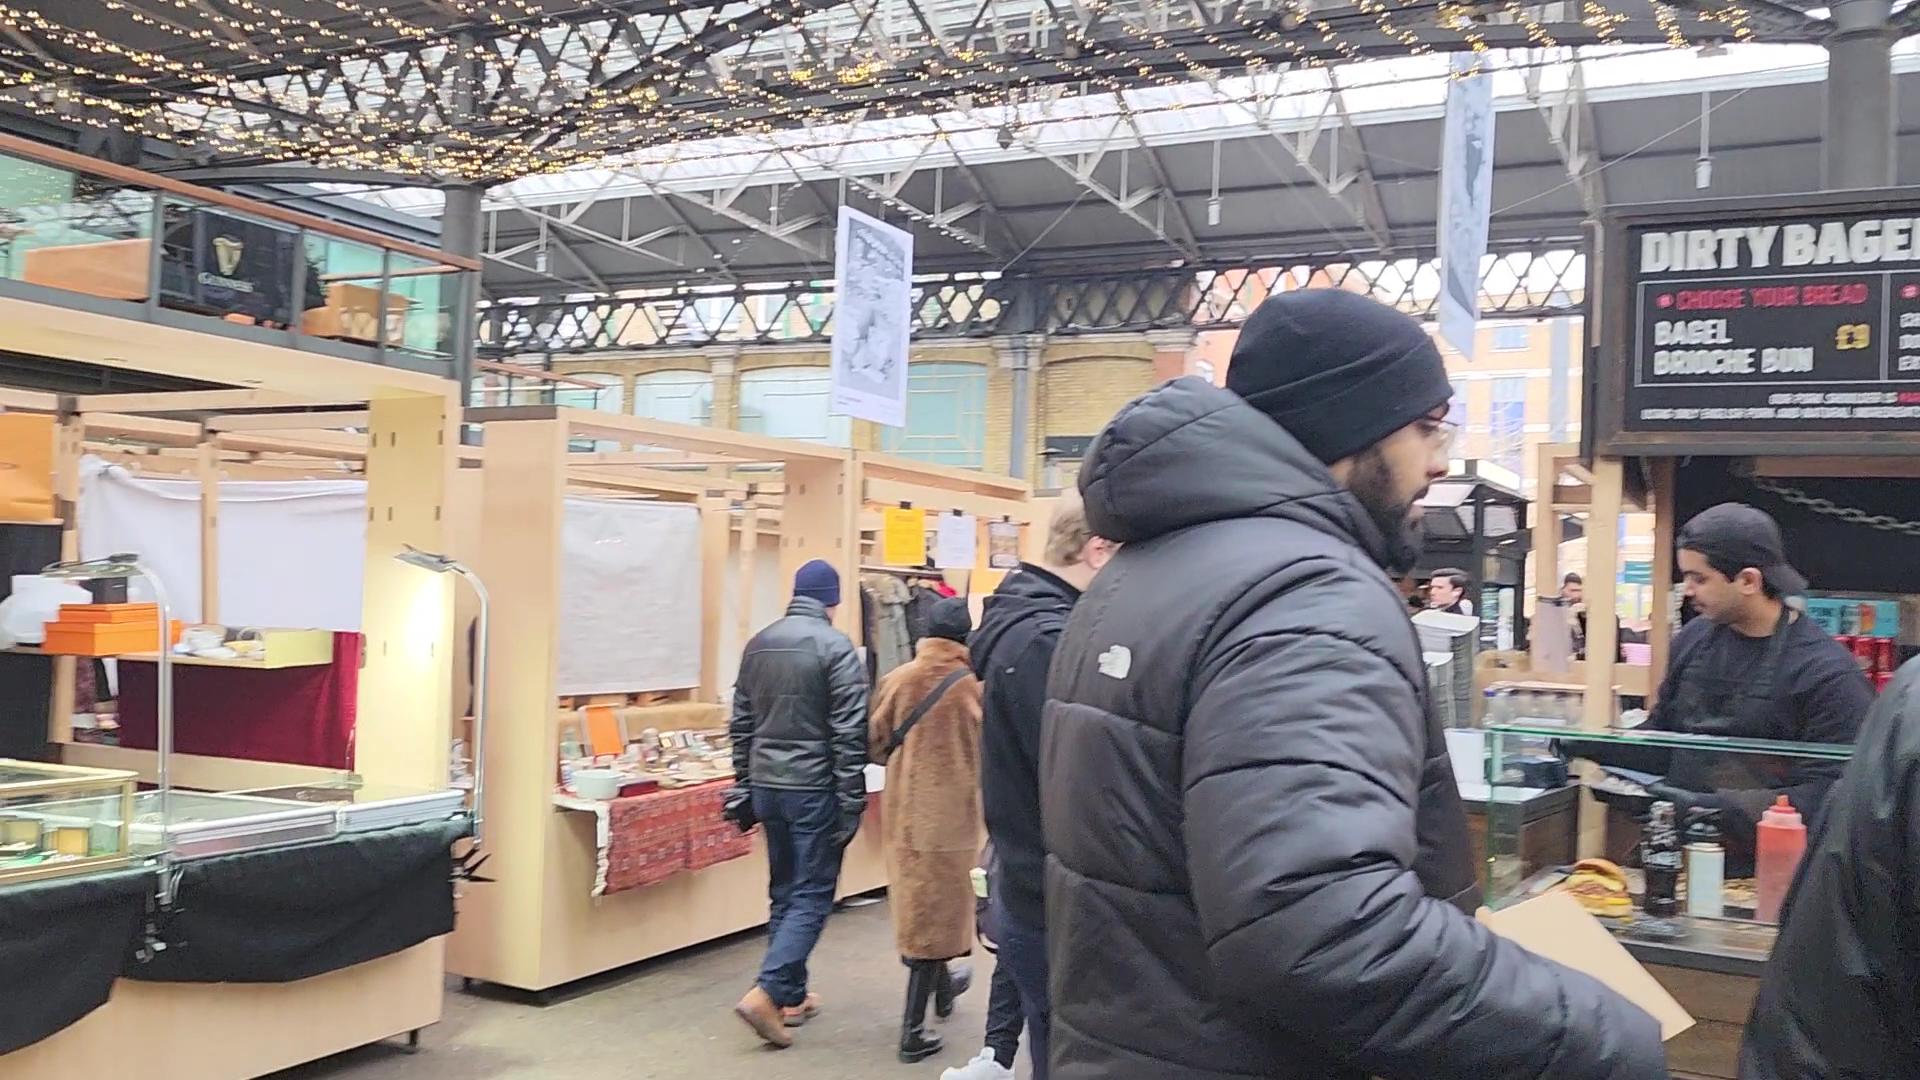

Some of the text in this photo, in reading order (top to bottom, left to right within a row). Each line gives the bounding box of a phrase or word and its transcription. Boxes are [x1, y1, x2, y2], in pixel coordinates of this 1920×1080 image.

[1640, 226, 1780, 273] DIRTY
[1676, 284, 1868, 311] CHOOSE YOUR BREAD
[1654, 319, 1733, 346] BAGEL
[1653, 347, 1814, 375] BRIOCHE BUN
